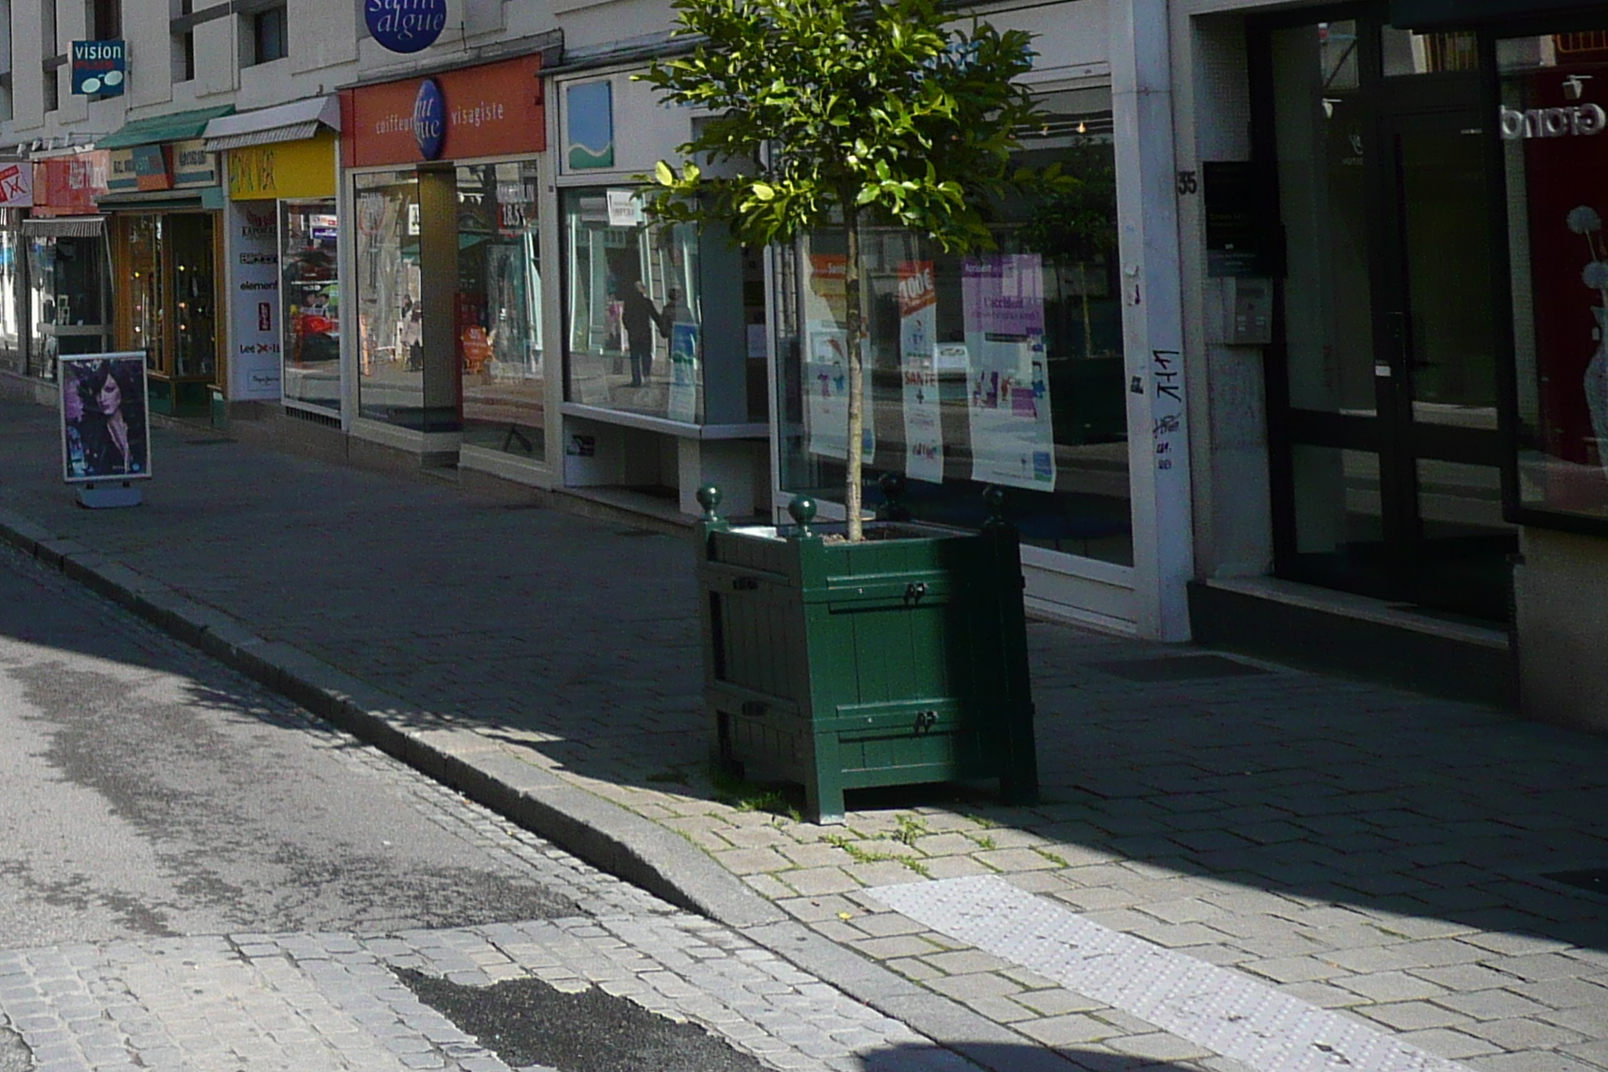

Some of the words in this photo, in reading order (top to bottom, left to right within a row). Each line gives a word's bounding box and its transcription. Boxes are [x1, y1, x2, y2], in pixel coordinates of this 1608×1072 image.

[377, 4, 442, 40] algue
[75, 42, 122, 59] vision
[75, 60, 115, 70] PLUS
[451, 101, 504, 127] visagiste
[1178, 170, 1198, 196] 35
[240, 280, 278, 291] element
